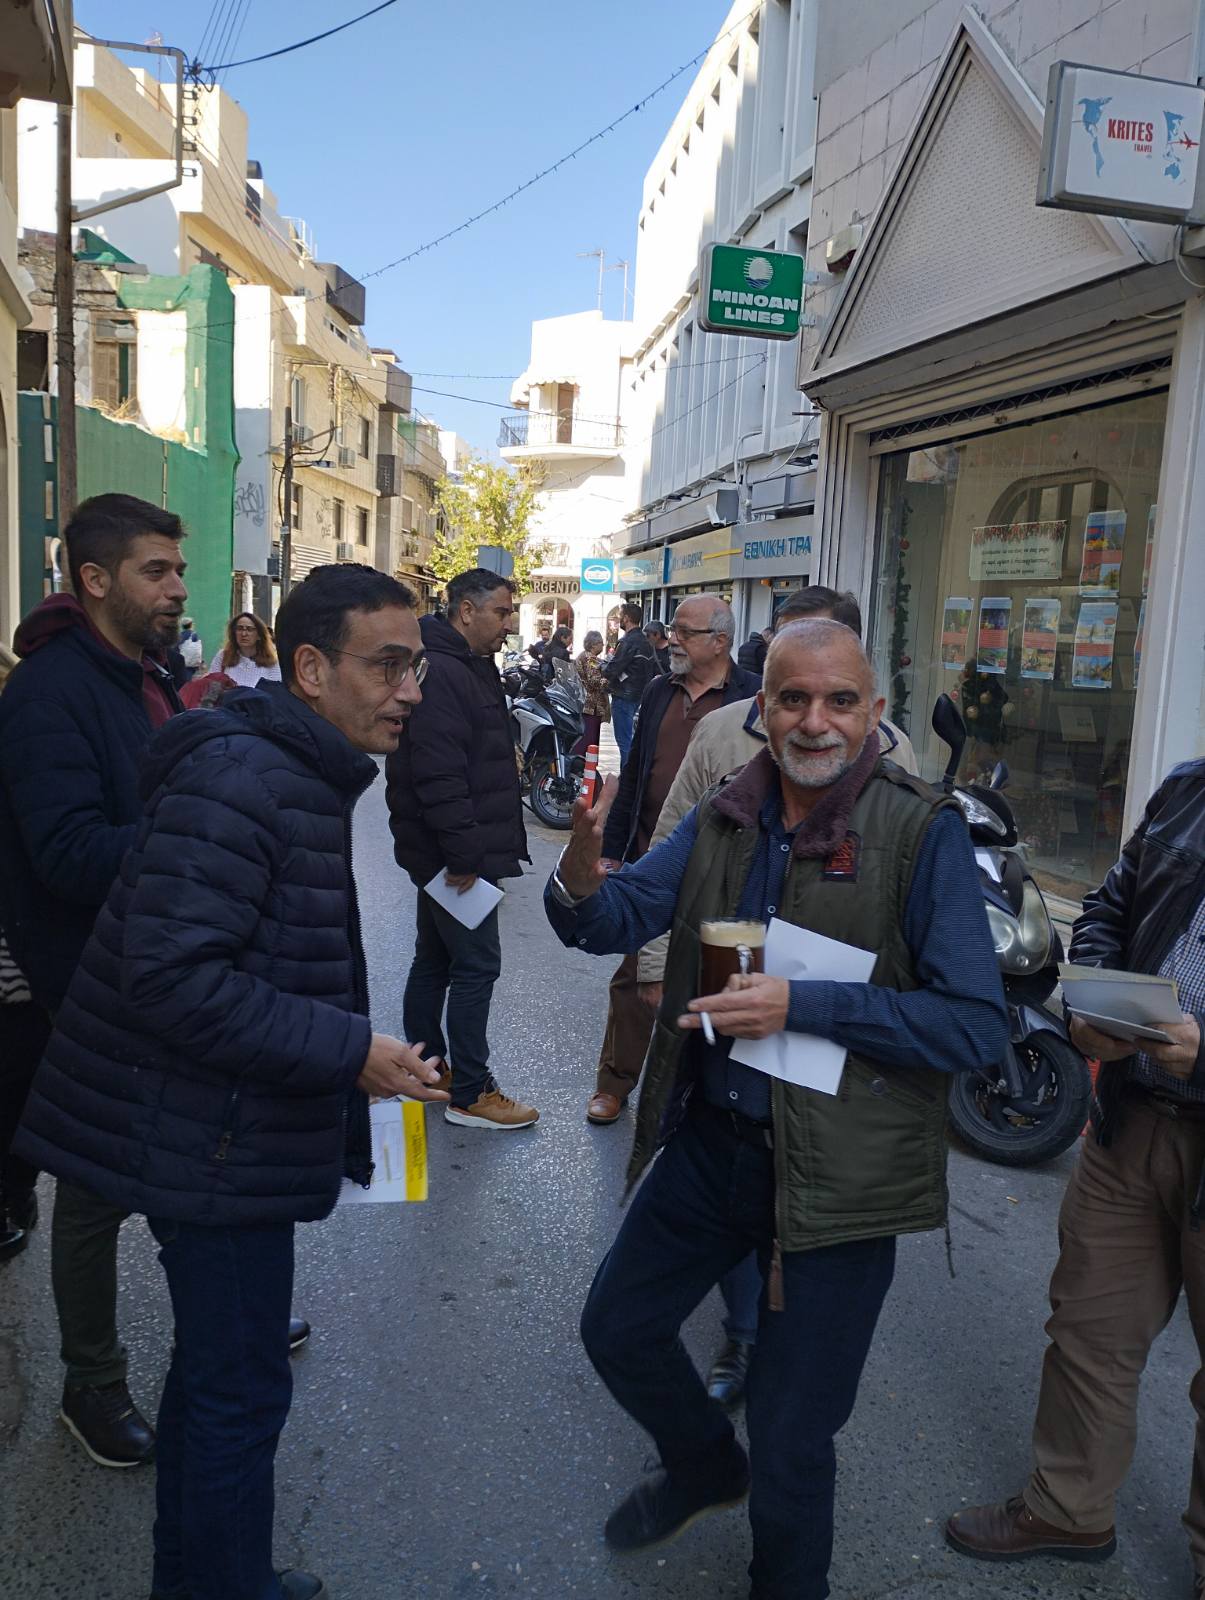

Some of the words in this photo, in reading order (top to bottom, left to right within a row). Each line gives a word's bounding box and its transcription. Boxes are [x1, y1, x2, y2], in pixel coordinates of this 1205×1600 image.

[1108, 118, 1154, 142] KRITES
[1134, 143, 1153, 153] TRAVEL
[712, 288, 799, 312] MINOAN
[724, 306, 785, 325] LINES
[744, 538, 785, 560] ΕΘΝΙΚΗ
[787, 535, 813, 556] ΤΡΑ
[531, 580, 580, 593] RGENTO
